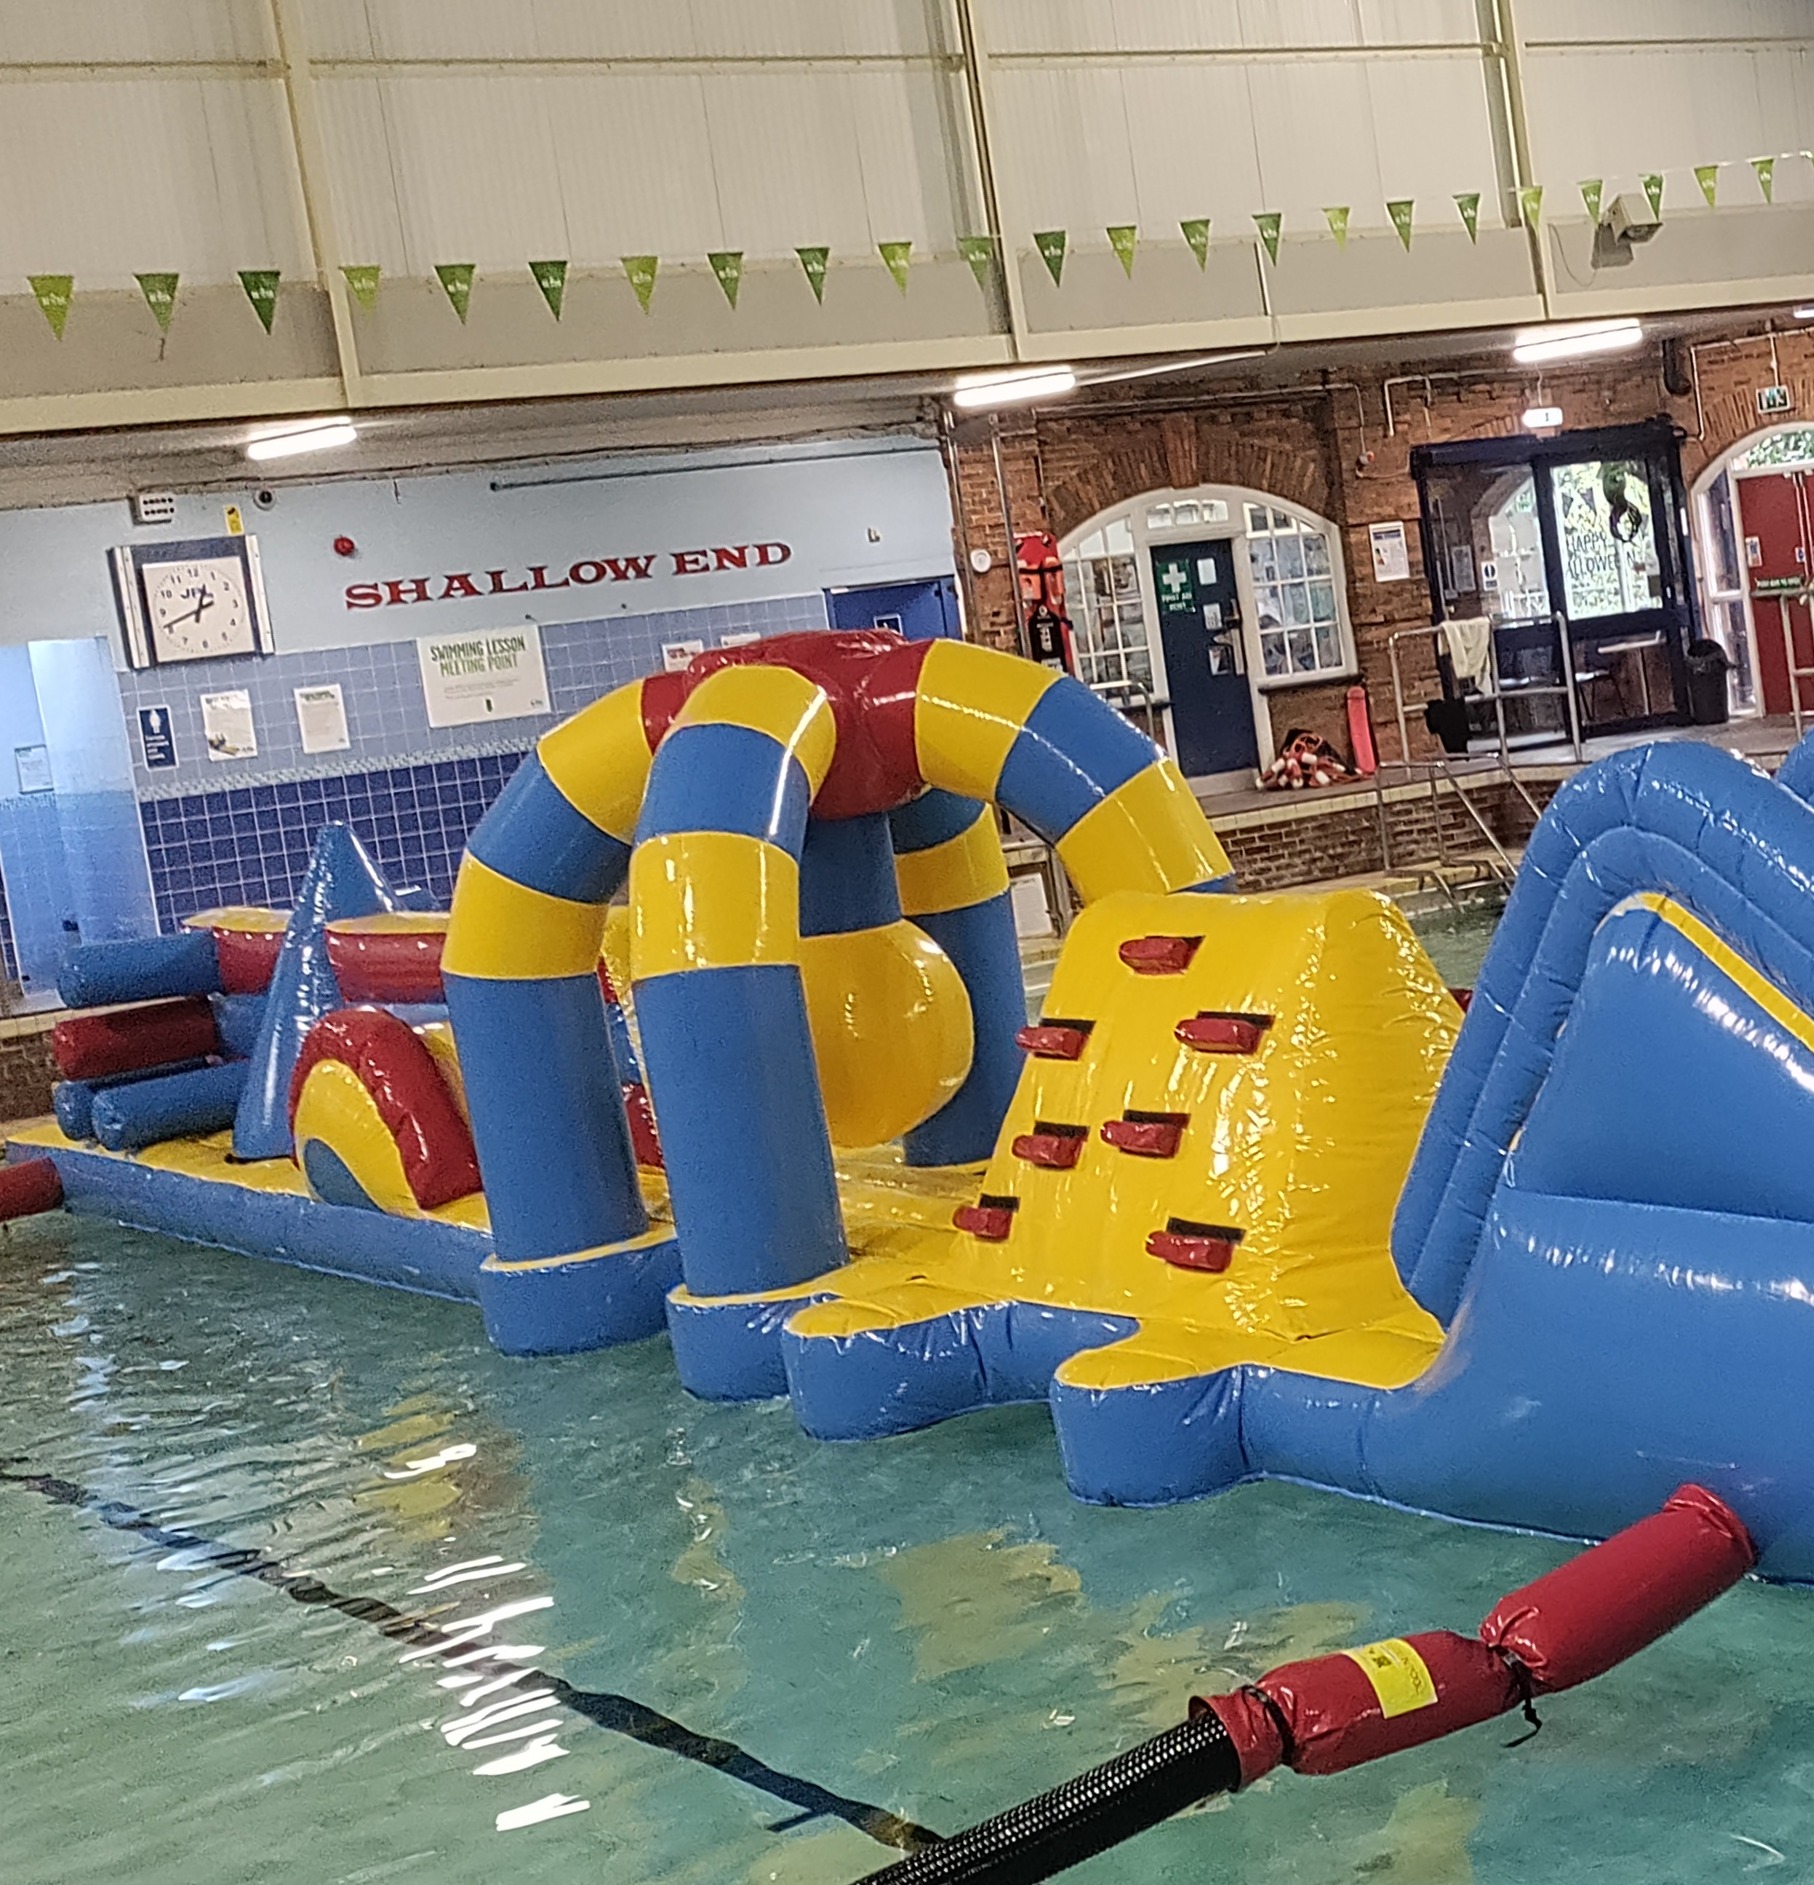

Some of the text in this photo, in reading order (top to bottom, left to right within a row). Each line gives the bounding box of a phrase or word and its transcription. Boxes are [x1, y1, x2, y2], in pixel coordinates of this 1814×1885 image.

[345, 542, 792, 610] SHALLOW END
[430, 635, 526, 662] SWIMMING LESSON
[440, 652, 518, 678] MEETING POINT
